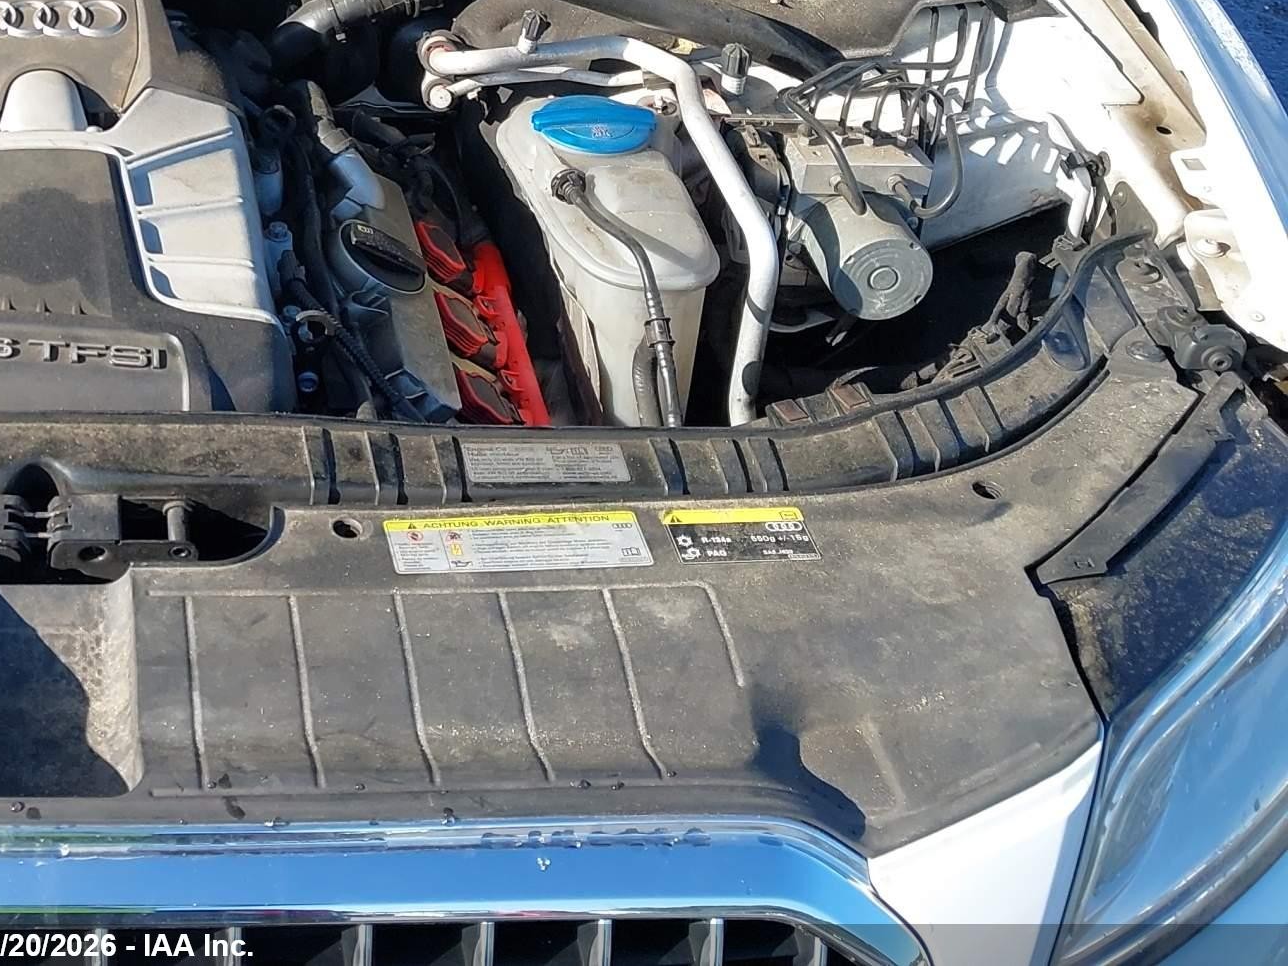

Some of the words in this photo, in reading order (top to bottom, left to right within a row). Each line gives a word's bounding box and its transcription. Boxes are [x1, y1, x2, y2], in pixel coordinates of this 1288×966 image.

[27, 338, 165, 370] TFSI
[423, 520, 477, 529] ACHTUNG
[484, 517, 541, 527] WARNING
[546, 514, 610, 524] ATTENTION
